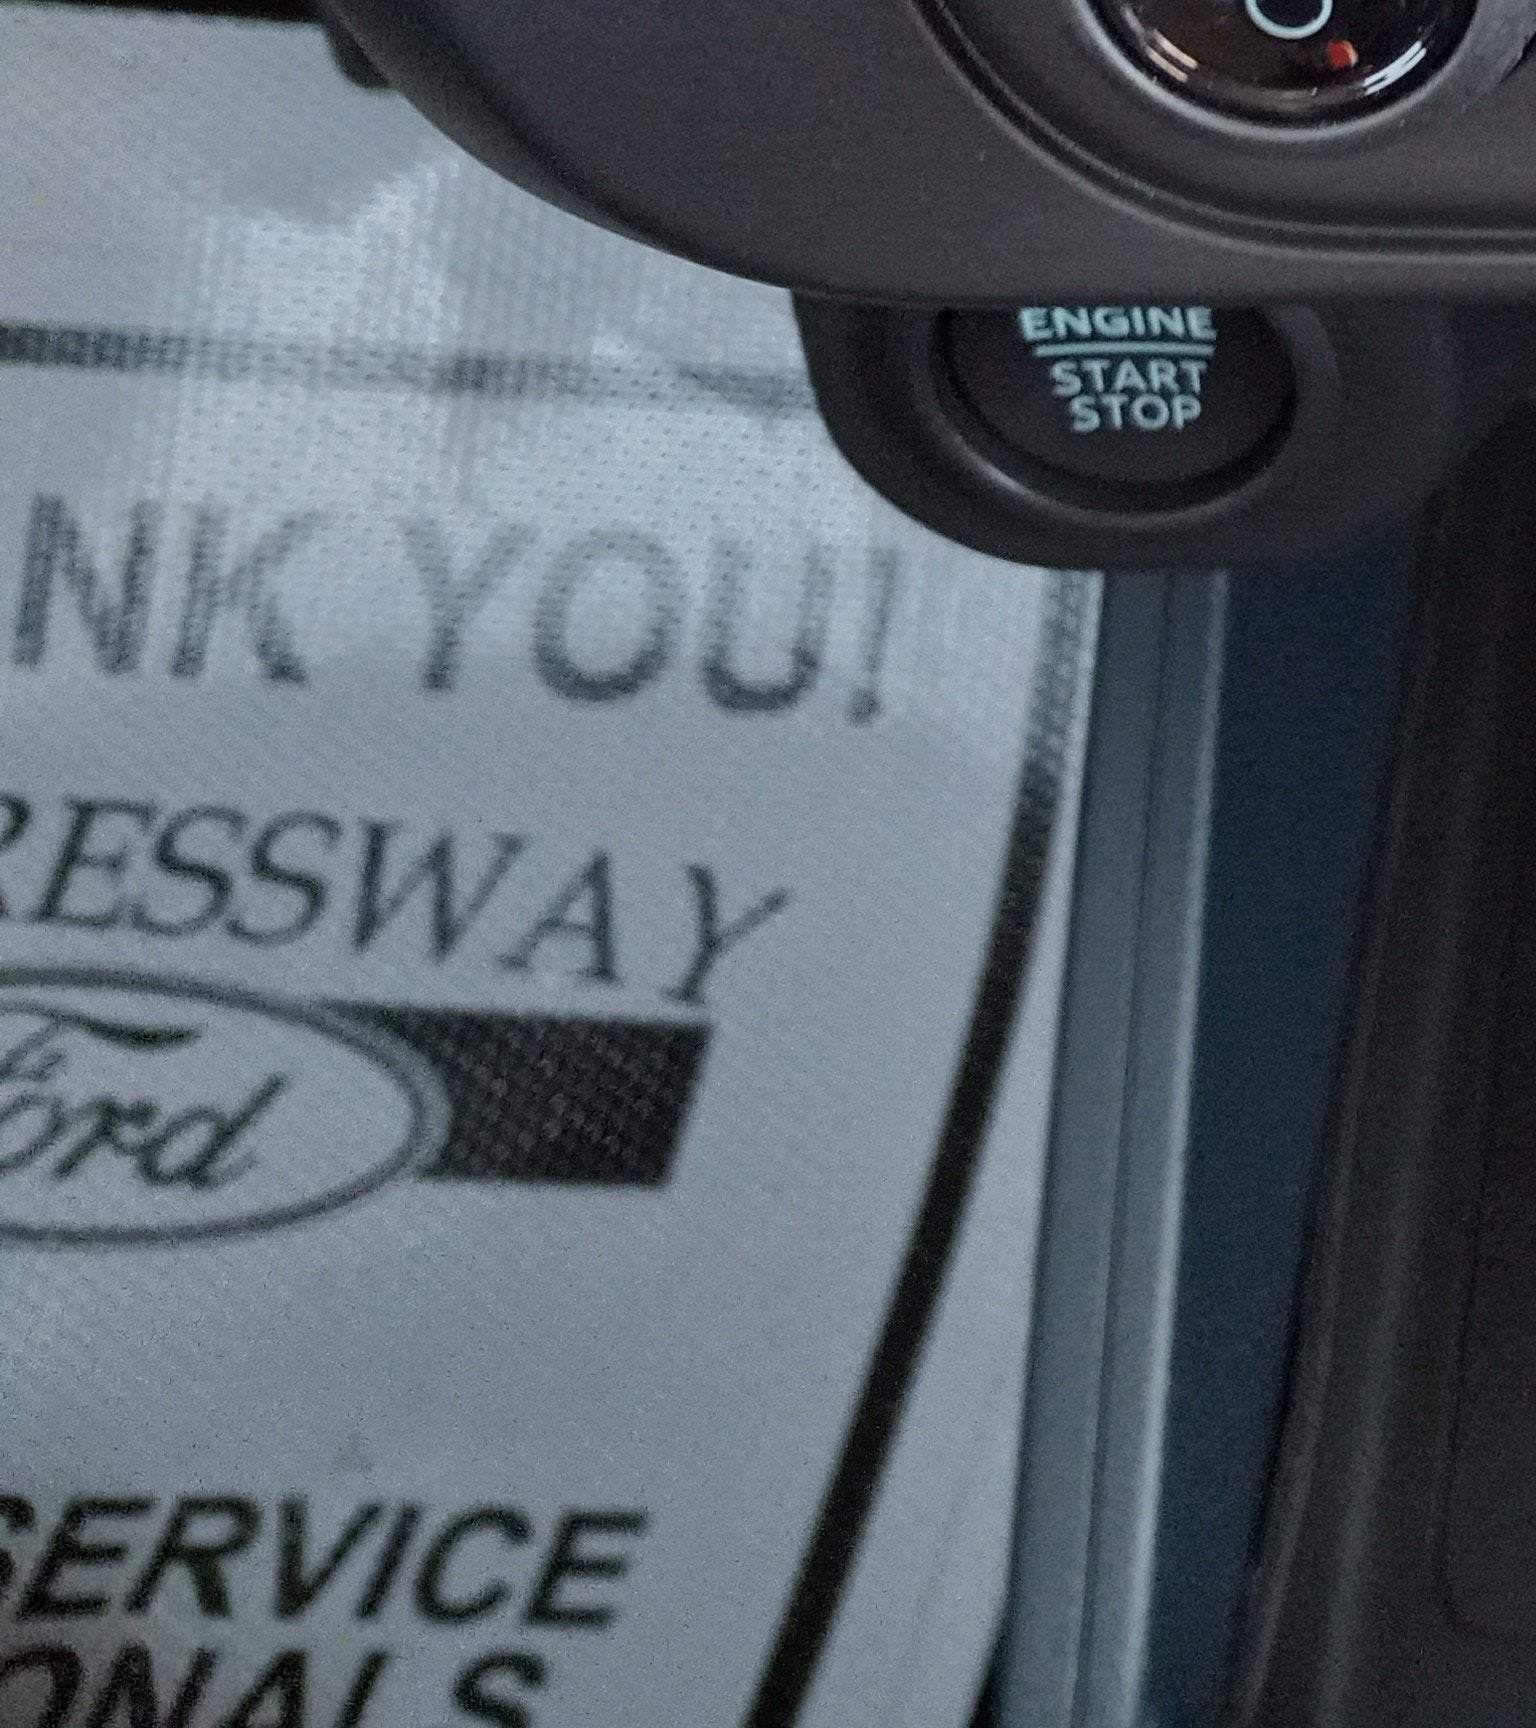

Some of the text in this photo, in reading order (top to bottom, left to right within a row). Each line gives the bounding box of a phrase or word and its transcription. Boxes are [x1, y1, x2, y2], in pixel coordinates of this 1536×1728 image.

[1019, 306, 1217, 342] ENGINE
[1051, 358, 1208, 396] START
[1070, 393, 1202, 433] STOP
[400, 510, 900, 726] YOU!
[0, 790, 790, 1006] ESSWAY
[0, 1494, 650, 1628] ERVICE
